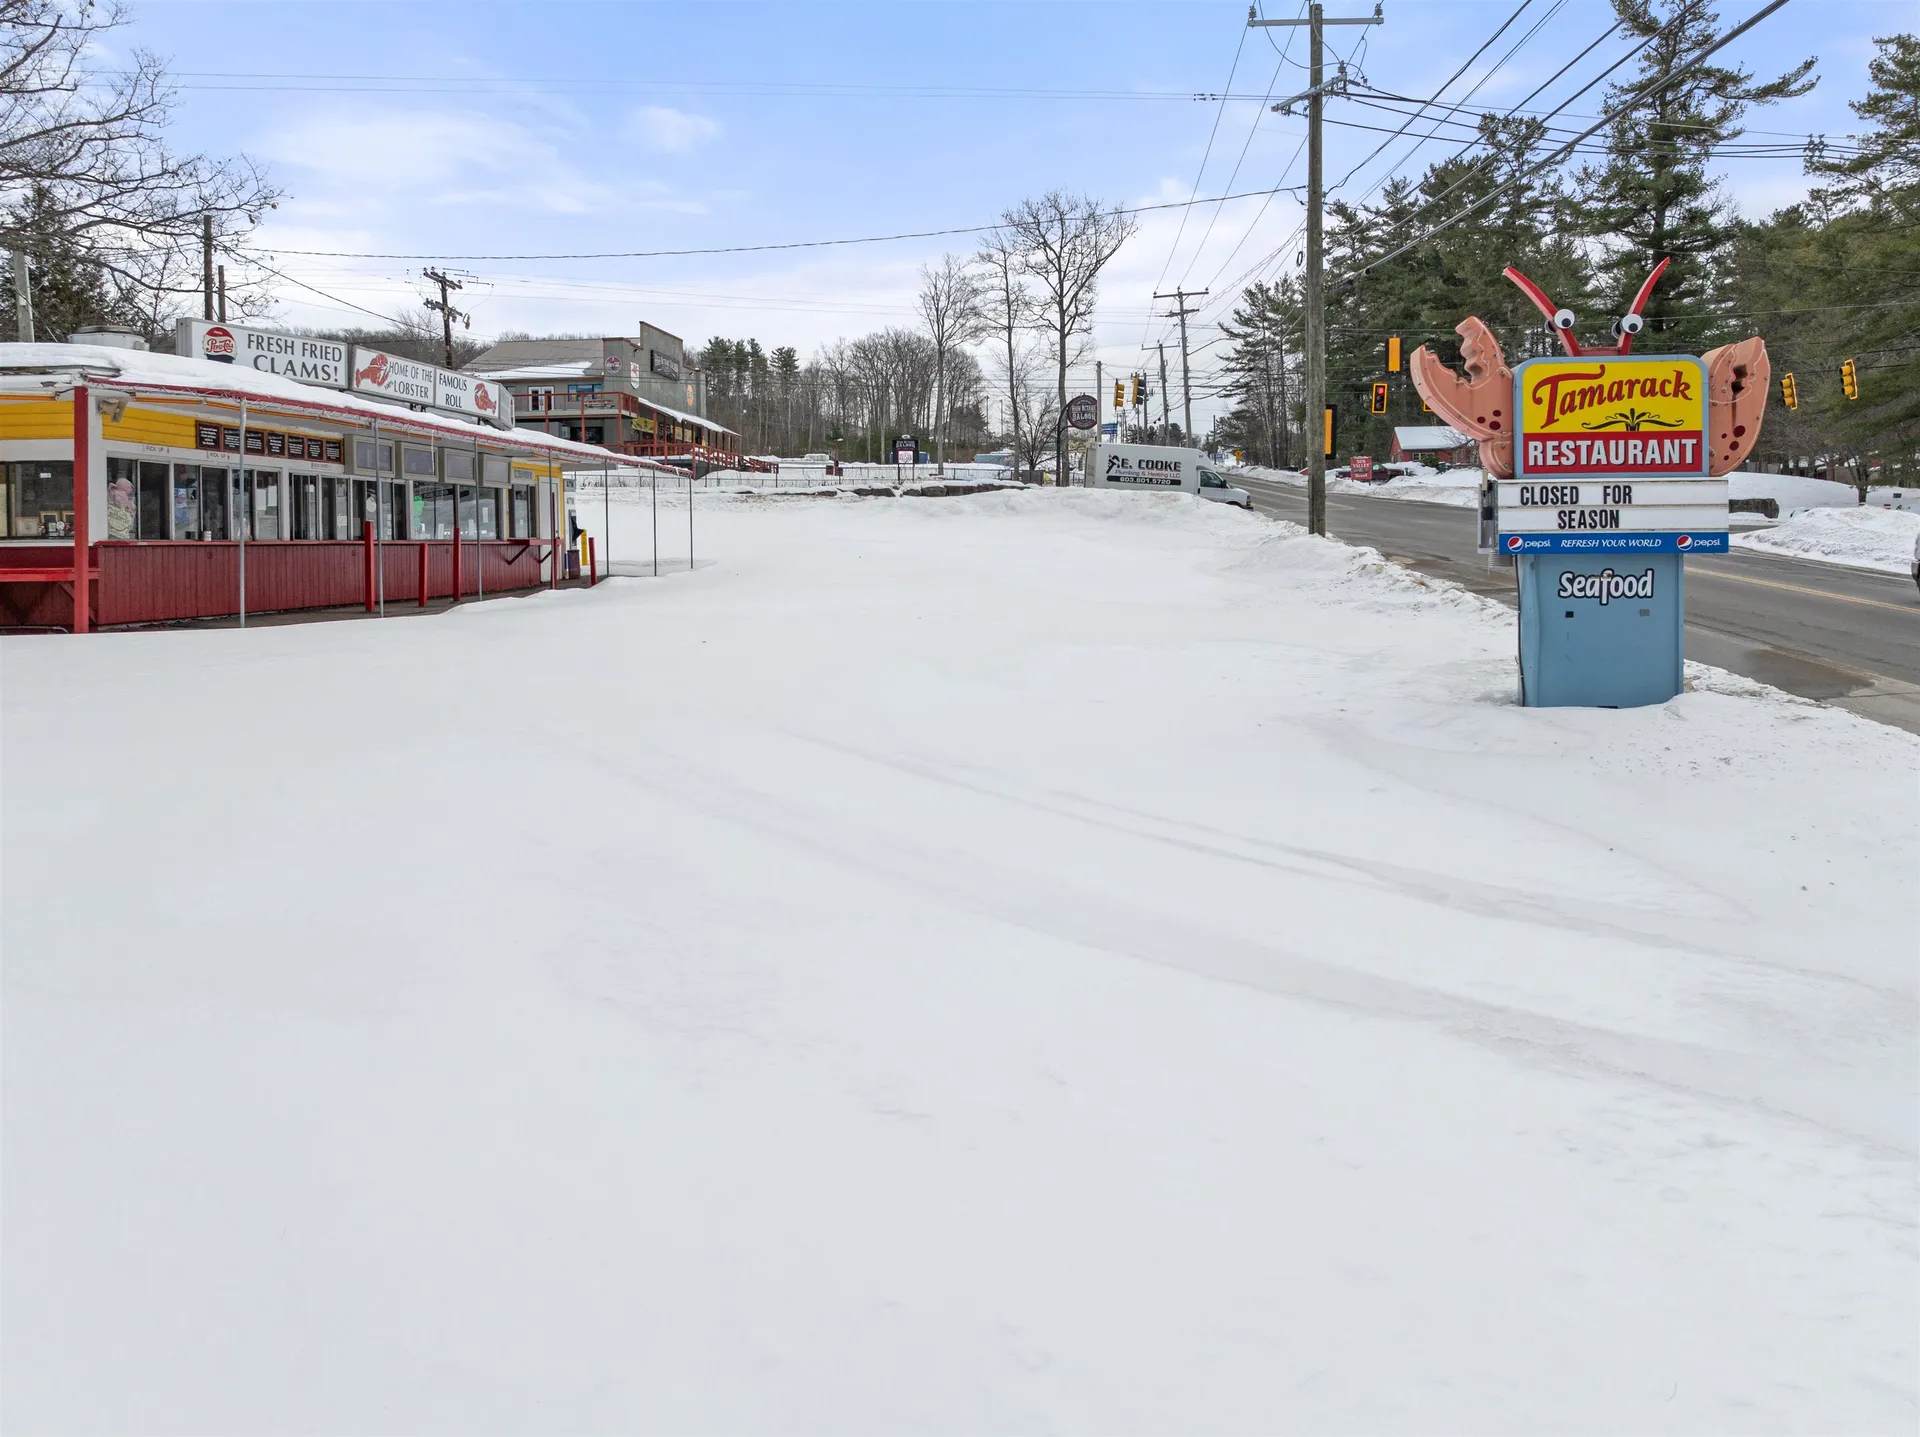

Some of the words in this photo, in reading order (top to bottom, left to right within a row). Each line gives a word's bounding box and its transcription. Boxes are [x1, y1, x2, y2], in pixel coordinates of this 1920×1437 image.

[247, 333, 295, 356] FRESH
[301, 342, 342, 363] FRIED
[253, 354, 338, 383] CLAMS!
[389, 361, 409, 378] HOME
[410, 366, 419, 380] OF
[421, 368, 433, 384] THE
[393, 380, 429, 400] LOBSTER
[438, 373, 468, 392] FAMOUS
[445, 393, 463, 409] ROLL
[1531, 363, 1694, 430] Tamarack
[1528, 438, 1698, 467] RESTAURANT
[1115, 469, 1140, 477] Plumbing
[1138, 459, 1182, 472] COOKE
[1520, 485, 1580, 506] CLOSED
[1603, 484, 1632, 505] FOR
[1557, 509, 1620, 530] SEASON
[1524, 539, 1551, 549] pepsi
[1560, 539, 1599, 548] REFRESH
[1601, 539, 1627, 548] YOUR
[1628, 538, 1662, 547] WORLD
[1693, 538, 1721, 548] pepsi
[1558, 567, 1655, 606] Seafood
